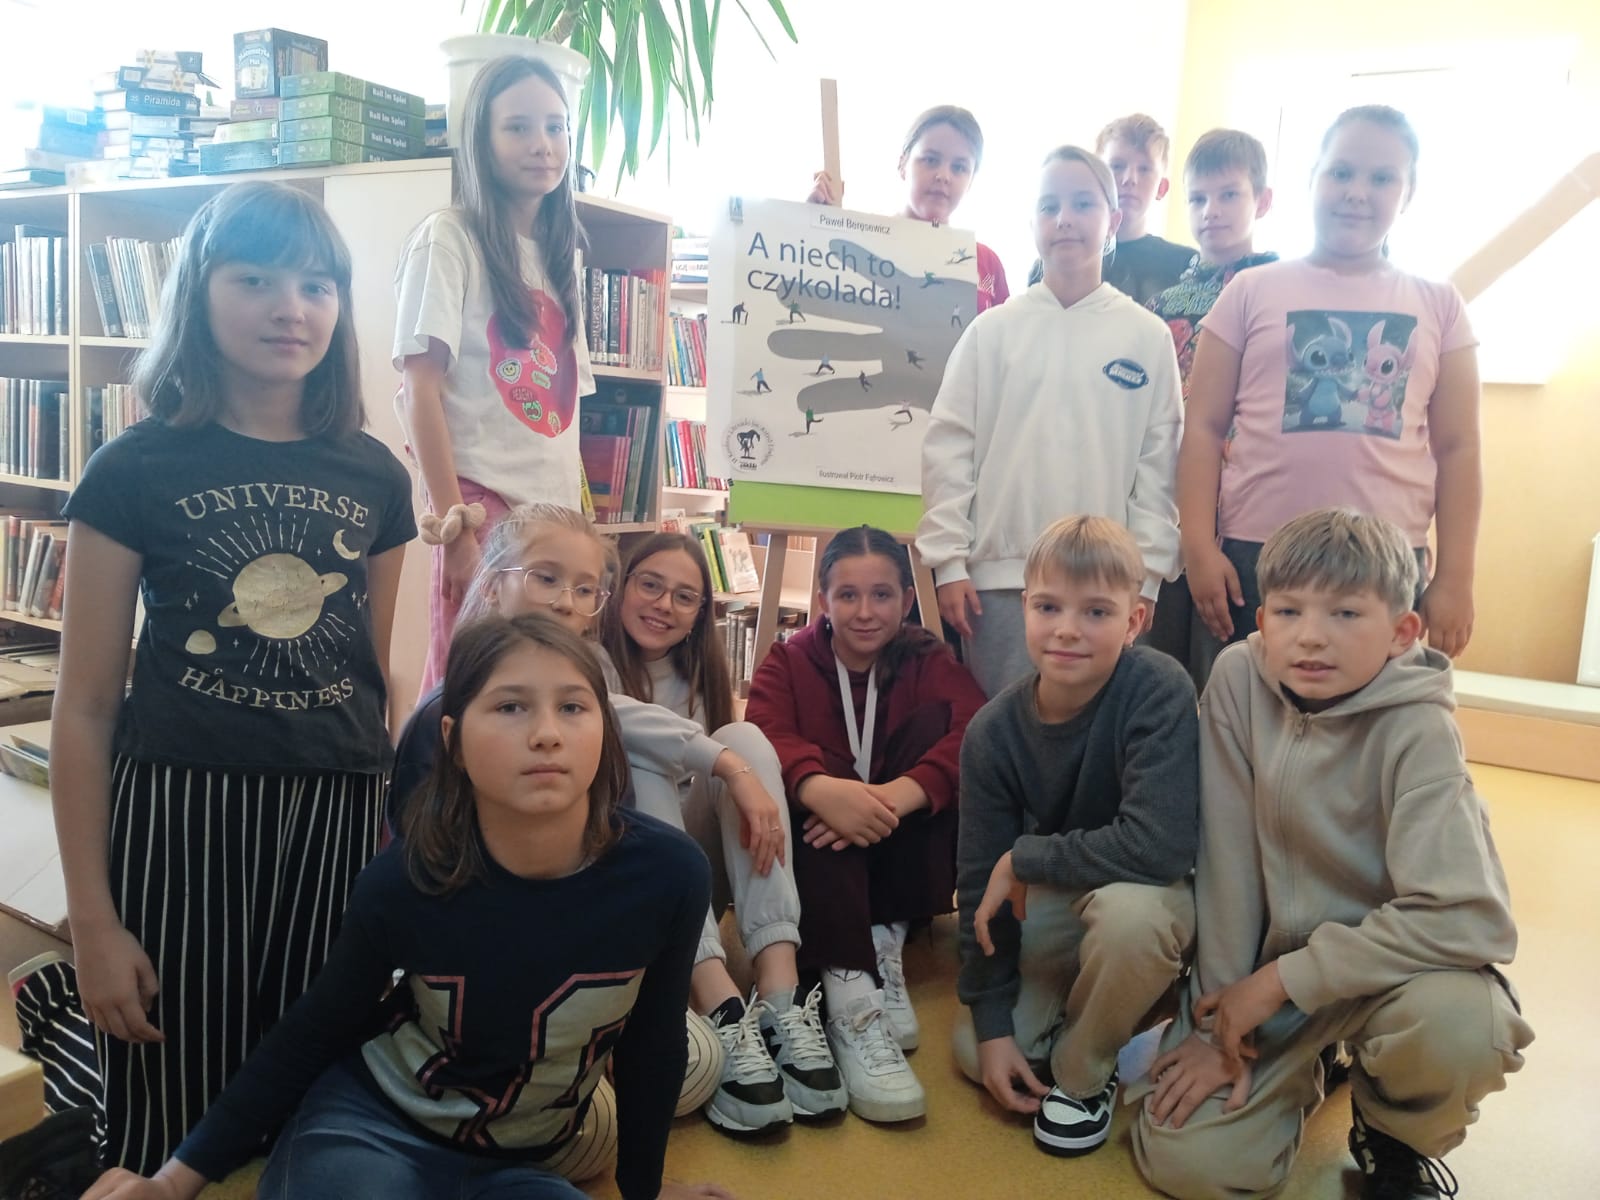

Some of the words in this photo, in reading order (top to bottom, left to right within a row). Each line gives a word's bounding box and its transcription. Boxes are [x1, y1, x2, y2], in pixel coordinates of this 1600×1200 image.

[144, 95, 180, 107] Piramida
[748, 232, 769, 259] A
[780, 239, 857, 273] niech
[867, 254, 896, 279] to
[747, 269, 900, 310] czykolada!
[176, 483, 369, 528] UNIVERSE
[178, 666, 354, 710] HAPPINESS
